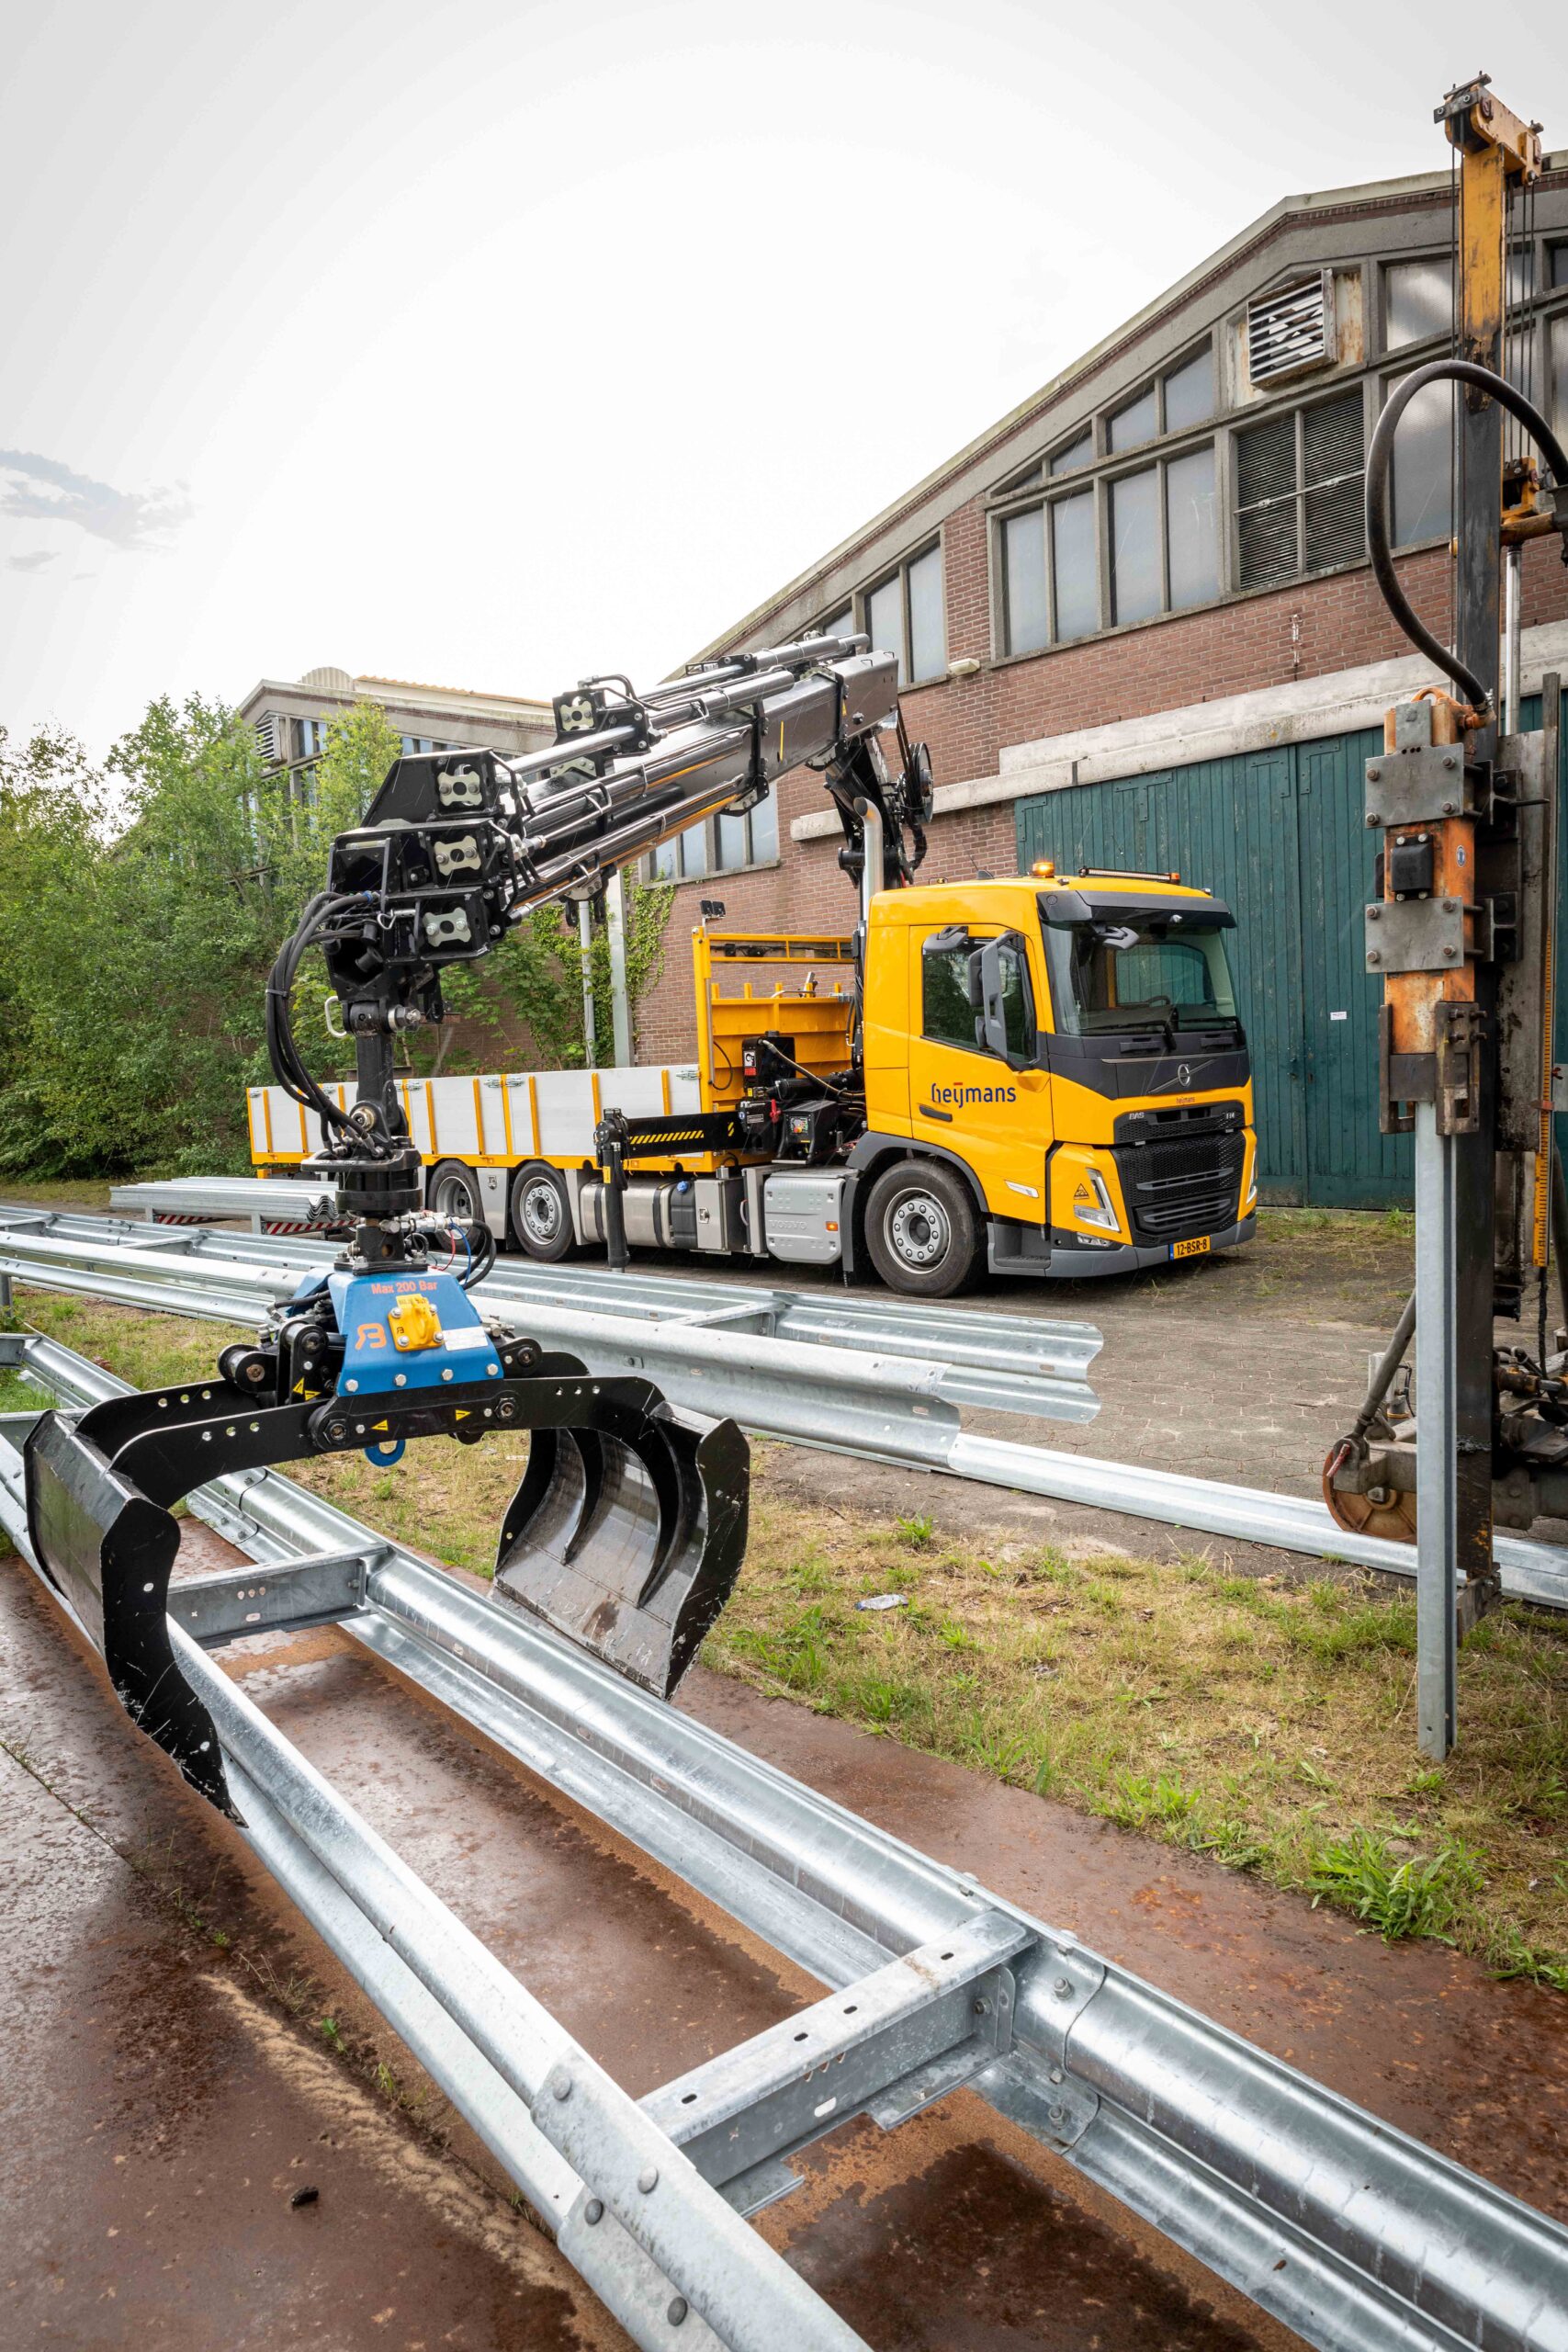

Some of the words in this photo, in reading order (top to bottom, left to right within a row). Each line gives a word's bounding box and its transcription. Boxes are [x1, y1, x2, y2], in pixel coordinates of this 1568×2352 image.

[931, 1082, 1016, 1109] heijmans
[1177, 1238, 1207, 1256] 12-BSR-8
[371, 1283, 394, 1294] Max
[395, 1281, 416, 1293] 200
[419, 1278, 437, 1291] Bar
